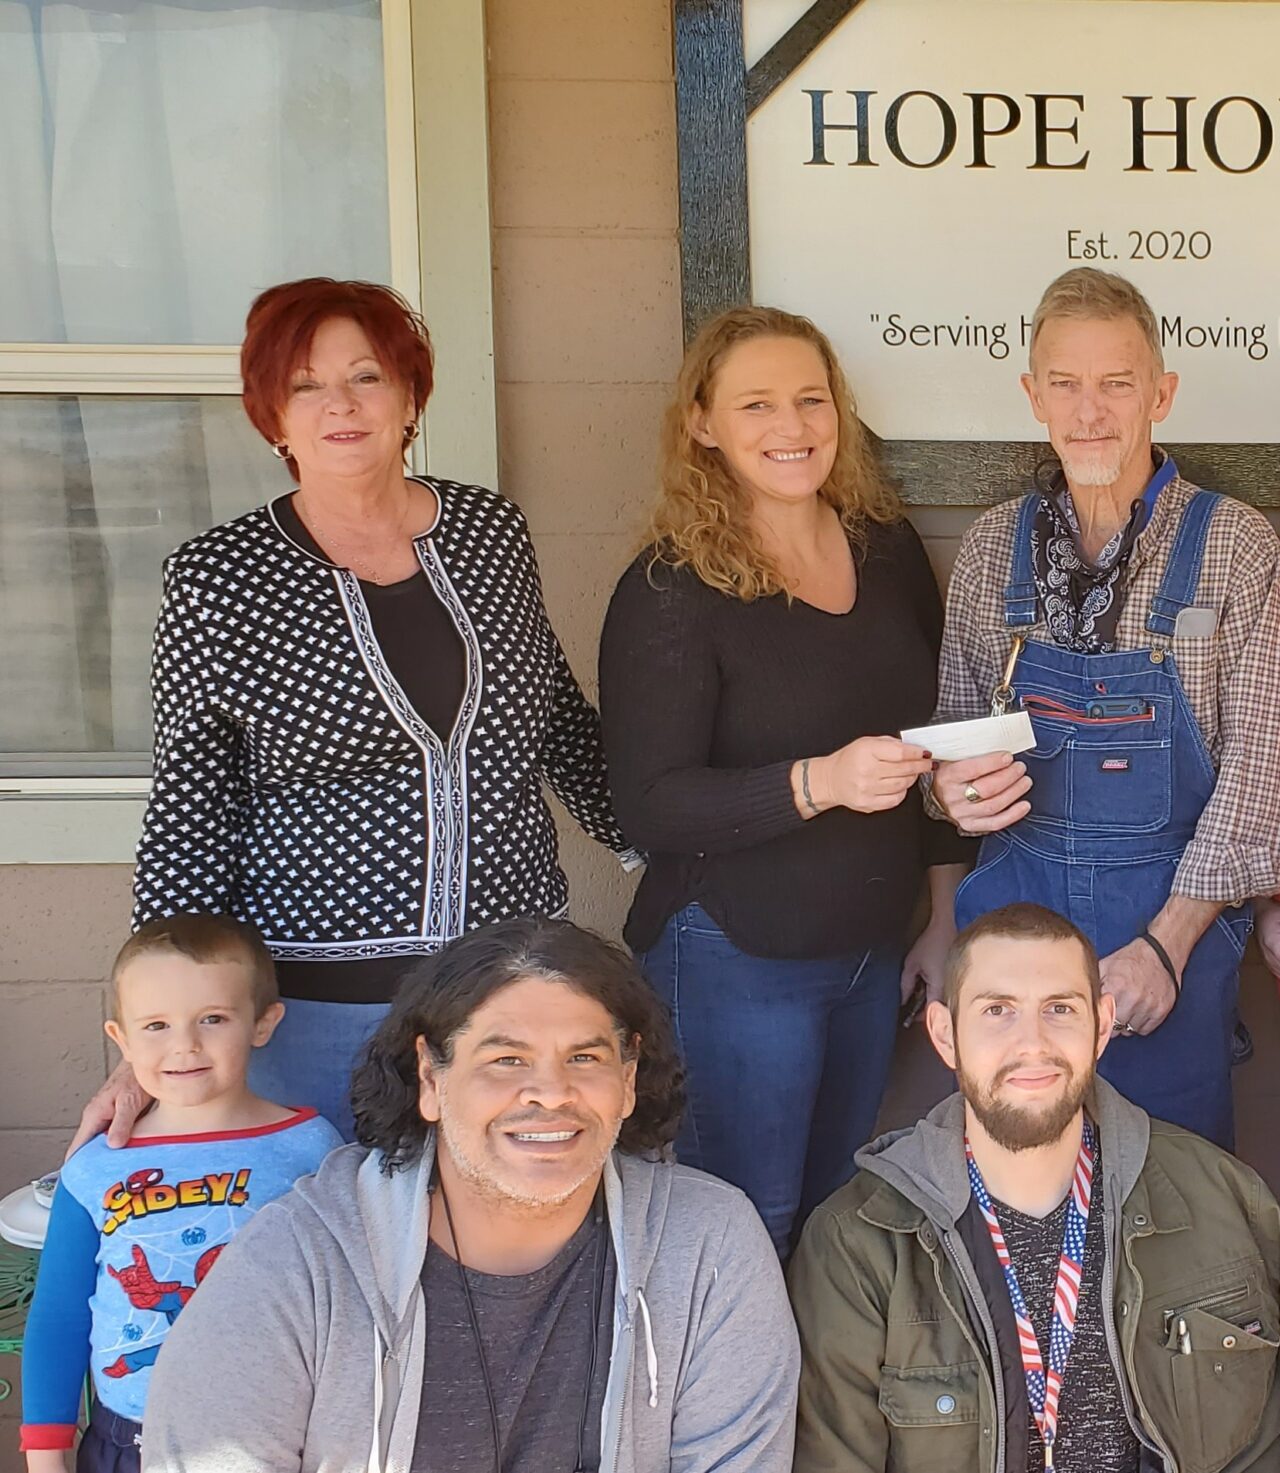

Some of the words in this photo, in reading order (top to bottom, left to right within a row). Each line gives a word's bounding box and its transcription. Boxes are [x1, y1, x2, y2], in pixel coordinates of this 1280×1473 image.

[802, 89, 1090, 170] HOPE
[1067, 229, 1118, 260] Est.
[1128, 230, 1212, 260] 2020
[870, 313, 1010, 360] "Serving
[1161, 315, 1269, 361] Moving
